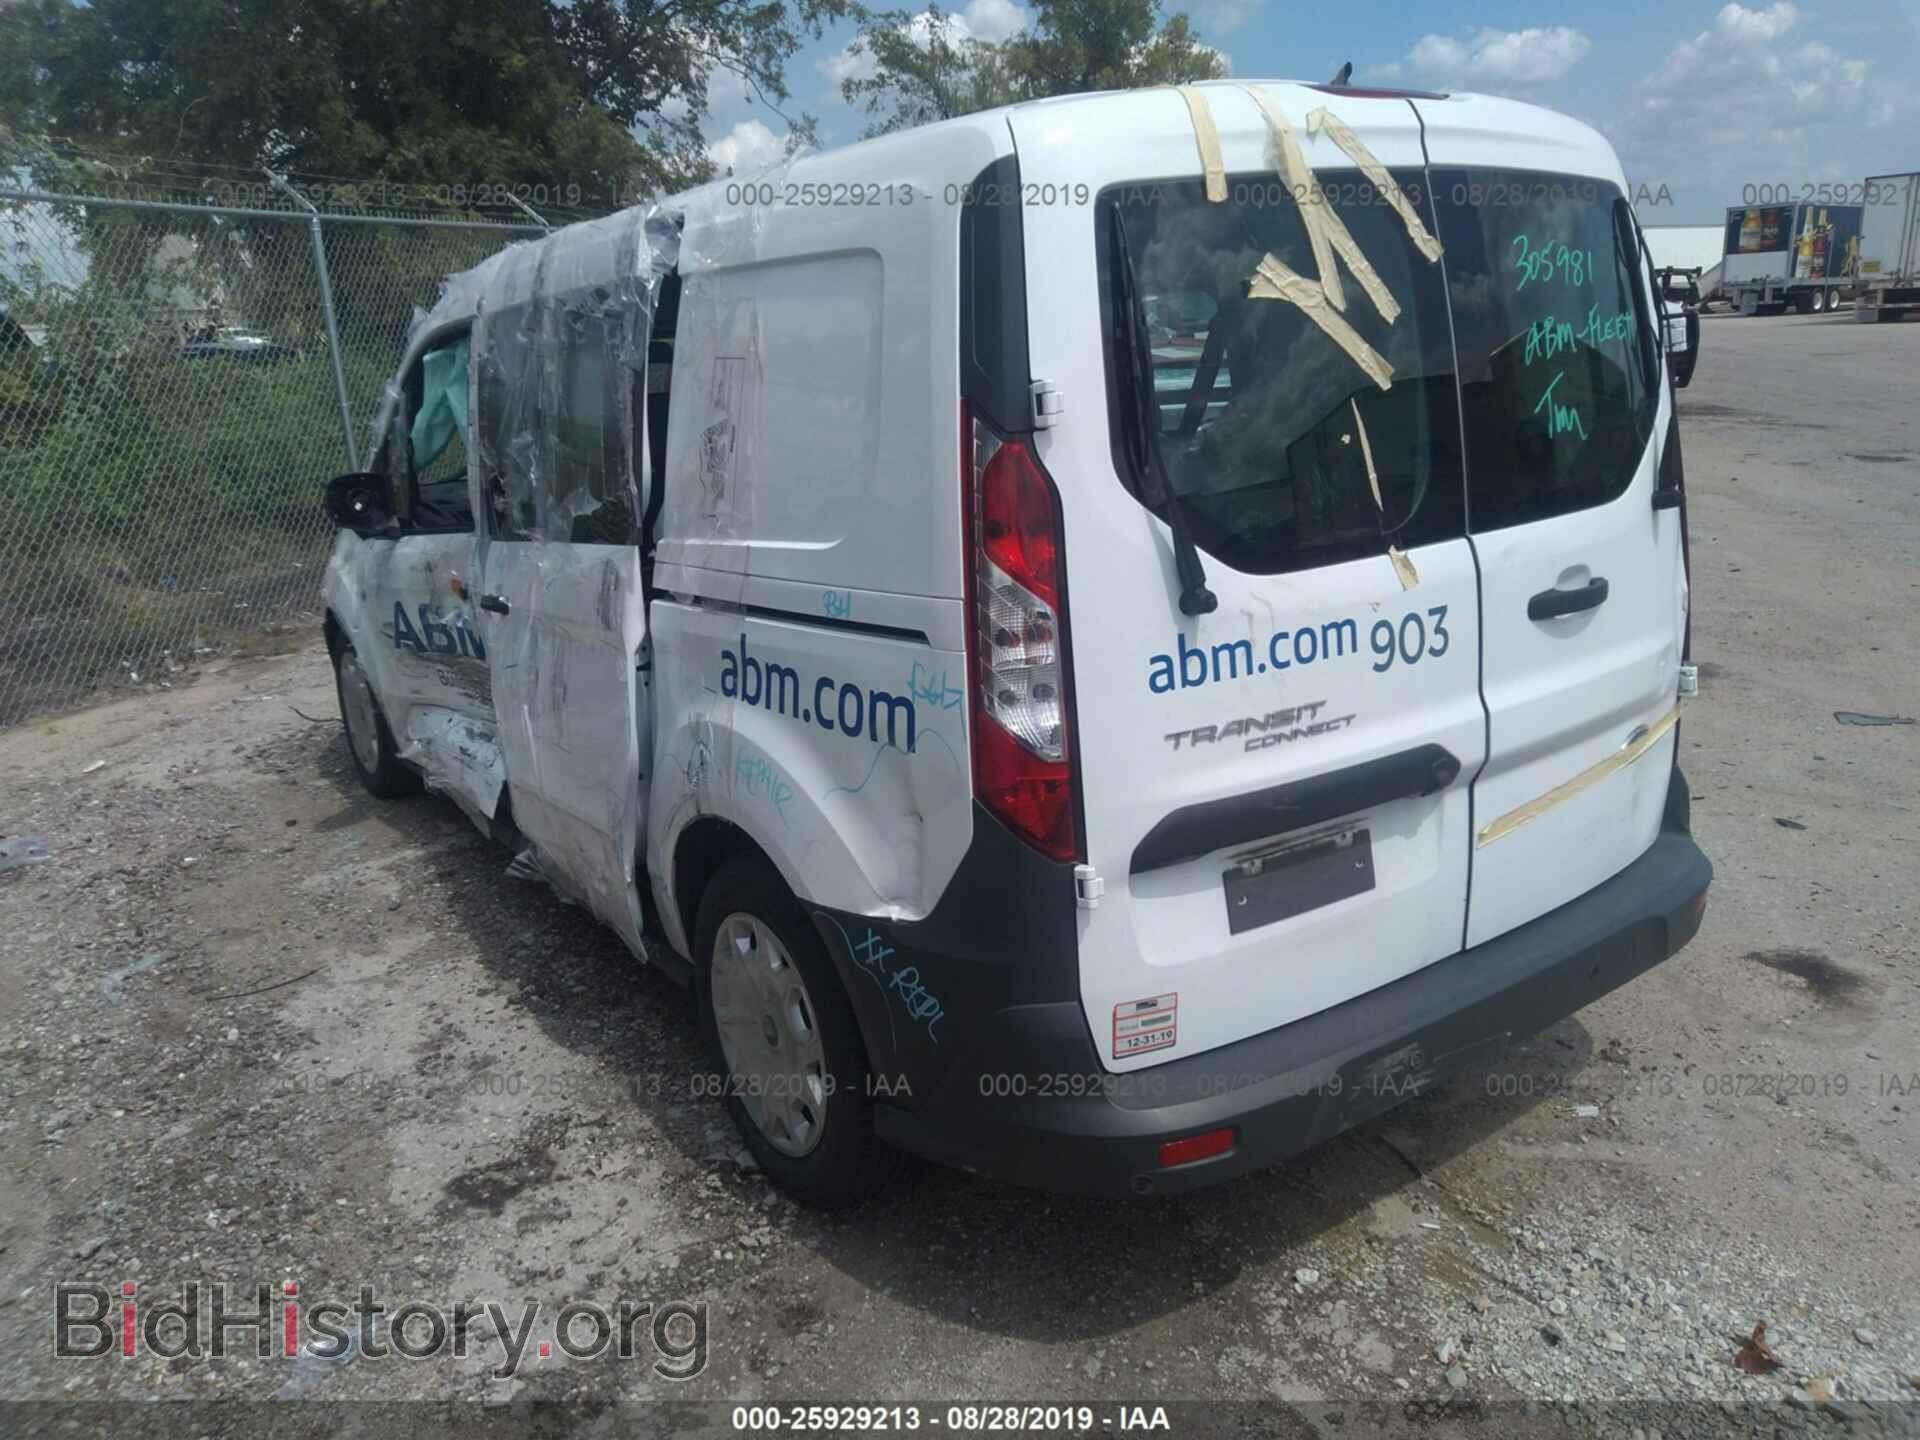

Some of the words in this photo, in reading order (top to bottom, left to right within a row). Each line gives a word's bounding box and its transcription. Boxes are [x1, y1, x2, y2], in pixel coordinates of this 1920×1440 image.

[1149, 613, 1358, 694] abm.com
[1370, 605, 1450, 673] 903
[720, 633, 916, 754] abm.com
[1164, 700, 1327, 750] TRANSIT
[1244, 714, 1357, 752] CONNECT
